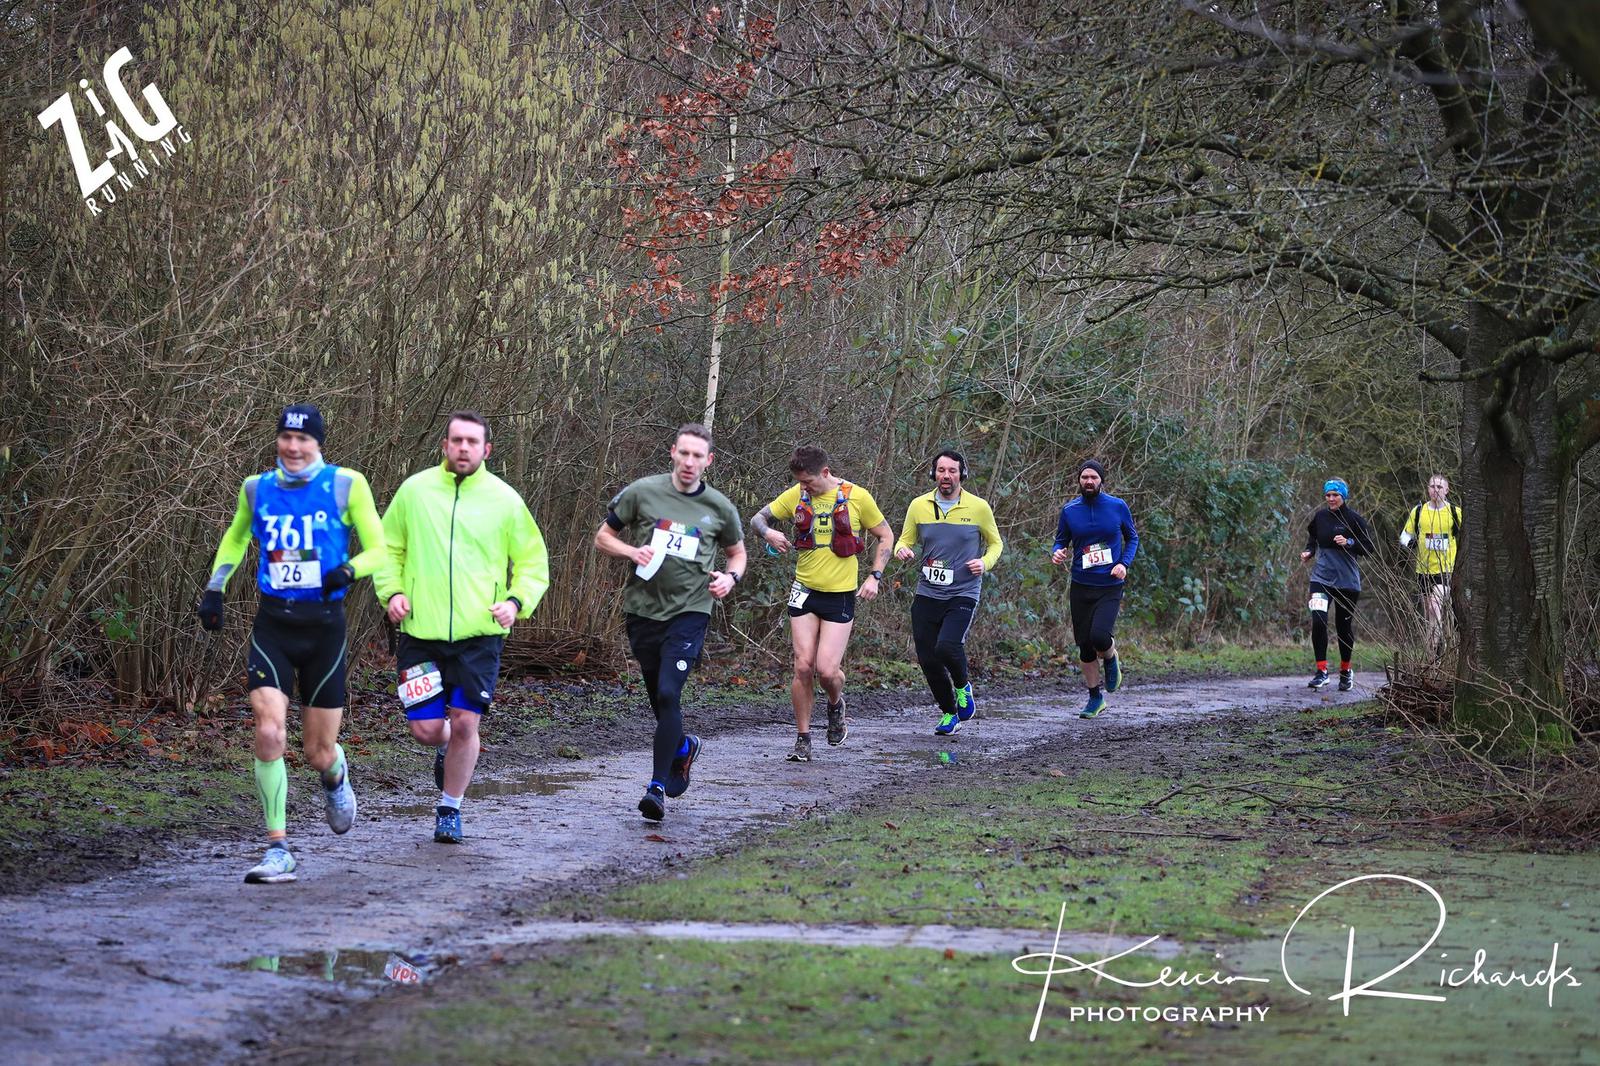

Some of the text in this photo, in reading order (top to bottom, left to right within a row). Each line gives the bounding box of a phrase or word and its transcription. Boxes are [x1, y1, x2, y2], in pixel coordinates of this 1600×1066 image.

[666, 533, 683, 551] 24
[1088, 551, 1105, 564] 451
[282, 564, 302, 582] 26
[928, 568, 946, 582] 196
[406, 676, 433, 699] 468
